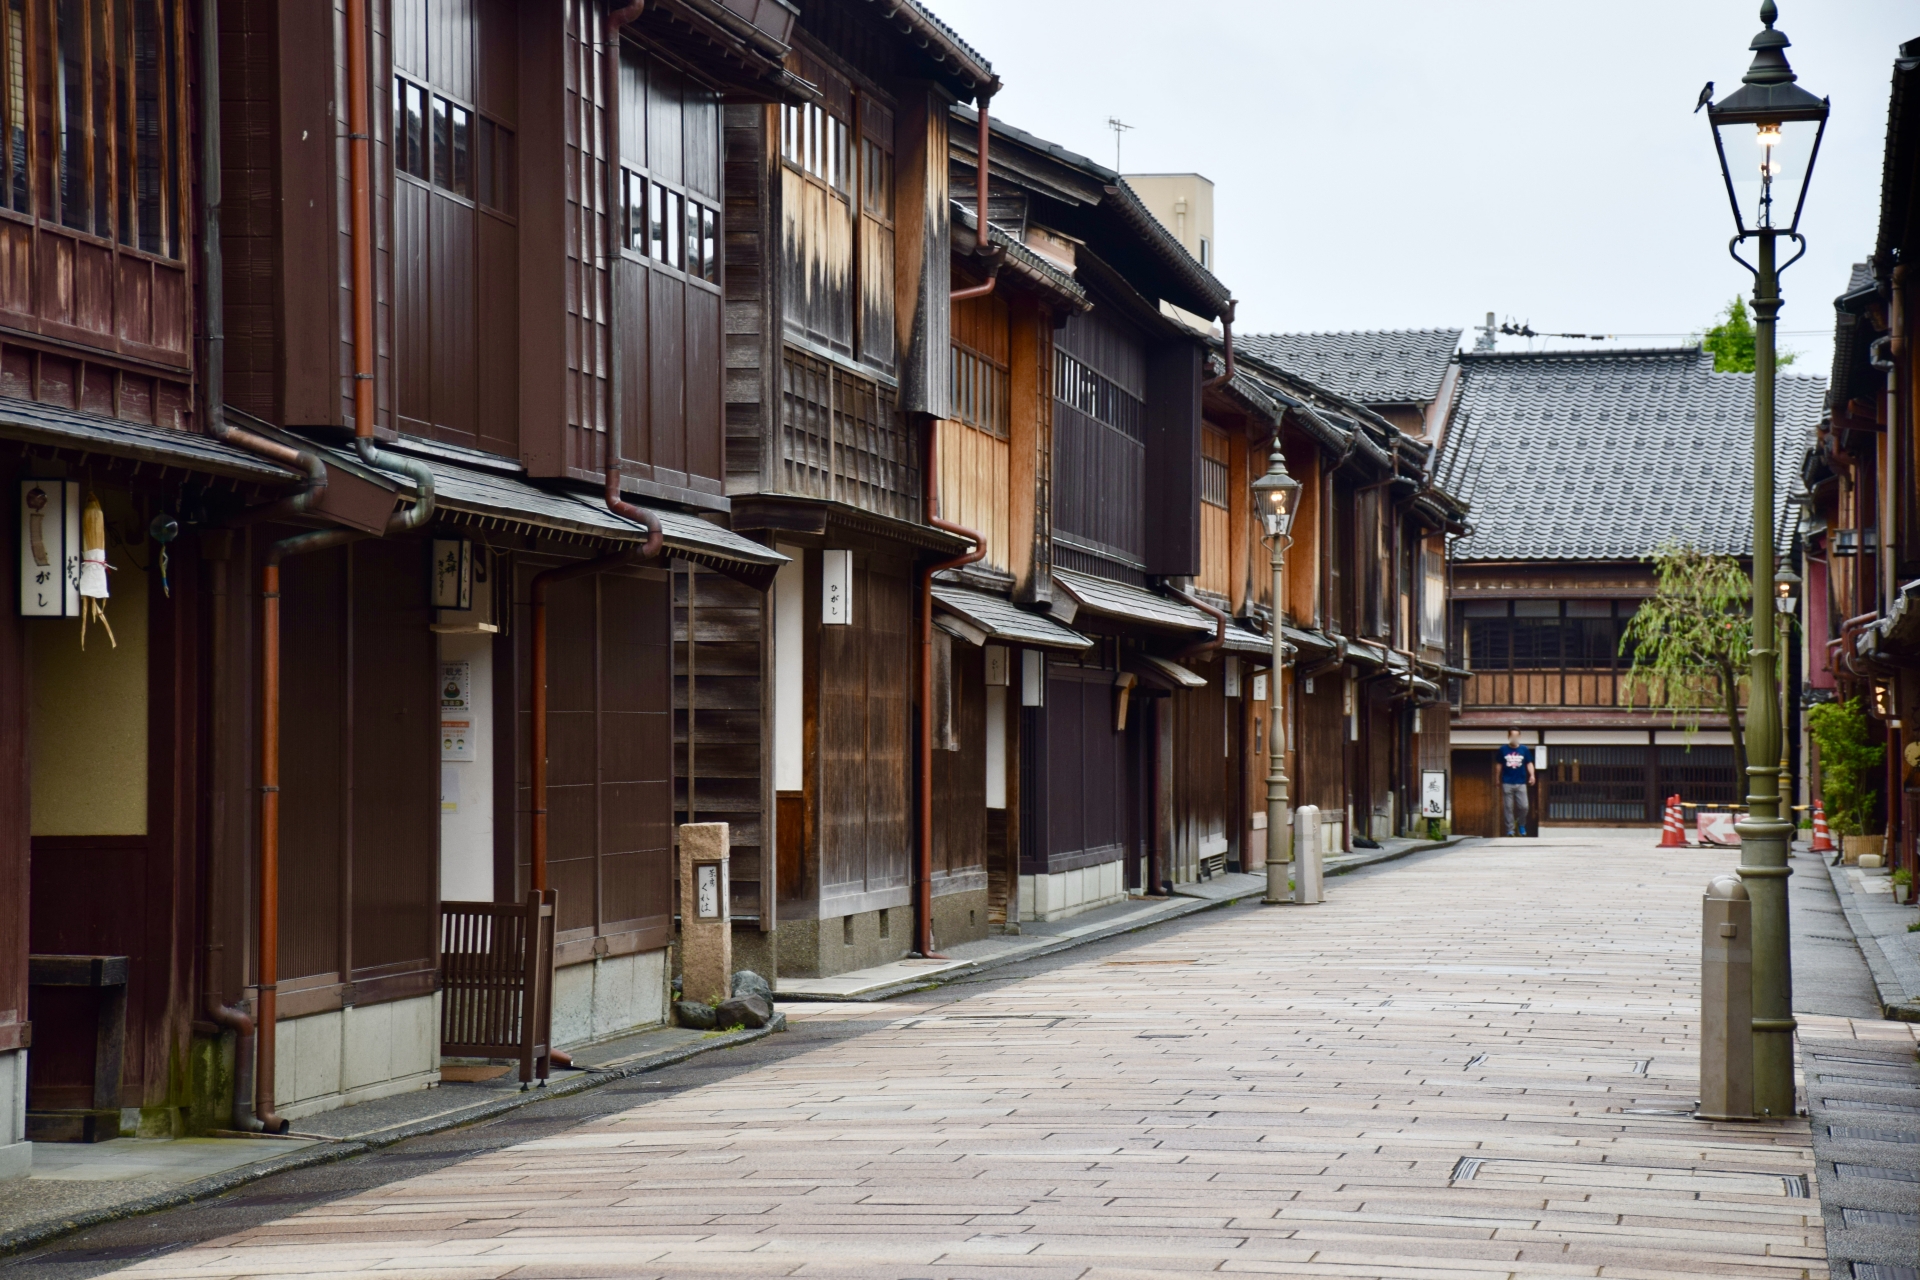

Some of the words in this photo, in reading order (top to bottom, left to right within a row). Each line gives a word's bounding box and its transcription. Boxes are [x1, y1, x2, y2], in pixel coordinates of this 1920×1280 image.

[35, 553, 51, 608] がし
[830, 584, 840, 616] ひがし
[446, 667, 462, 676] 観光
[700, 883, 711, 912] くれは
